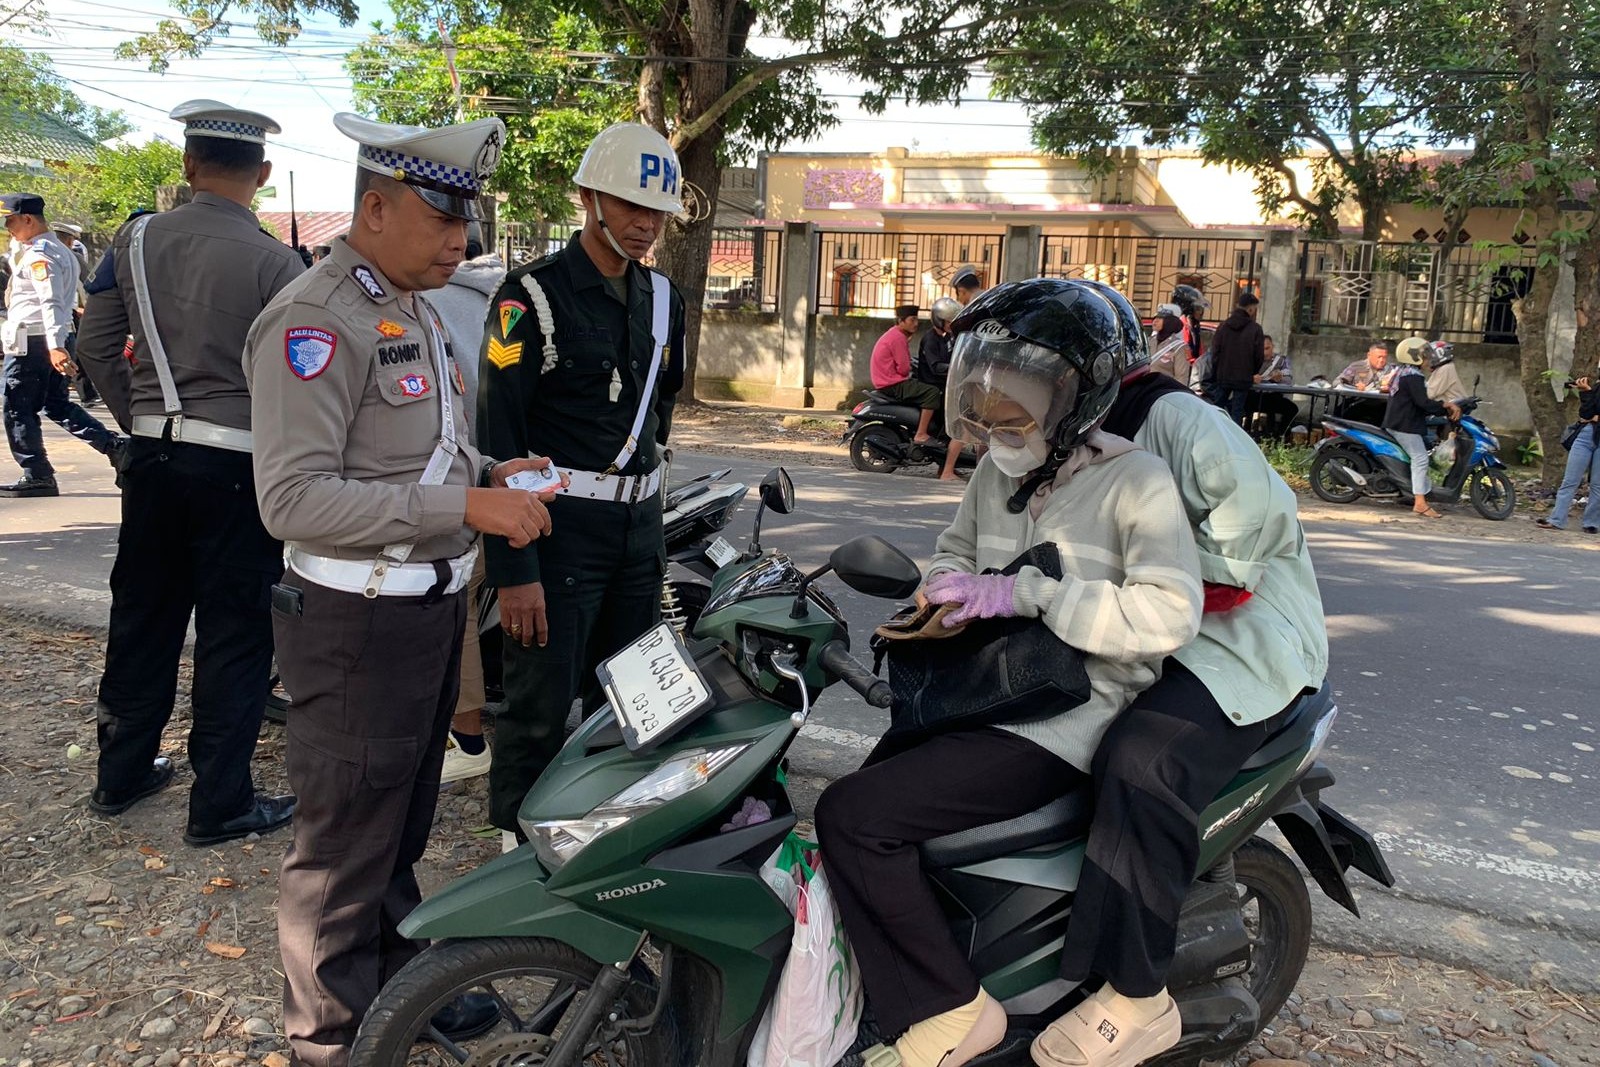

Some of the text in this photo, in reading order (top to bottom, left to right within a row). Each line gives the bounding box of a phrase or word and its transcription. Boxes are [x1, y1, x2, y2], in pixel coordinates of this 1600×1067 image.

[640, 153, 677, 195] PM
[503, 310, 518, 321] PM
[309, 330, 333, 342] LINTAS
[378, 343, 421, 366] RONNY
[637, 630, 664, 656] DR
[649, 653, 684, 691] 4349
[595, 878, 667, 901] HONDA
